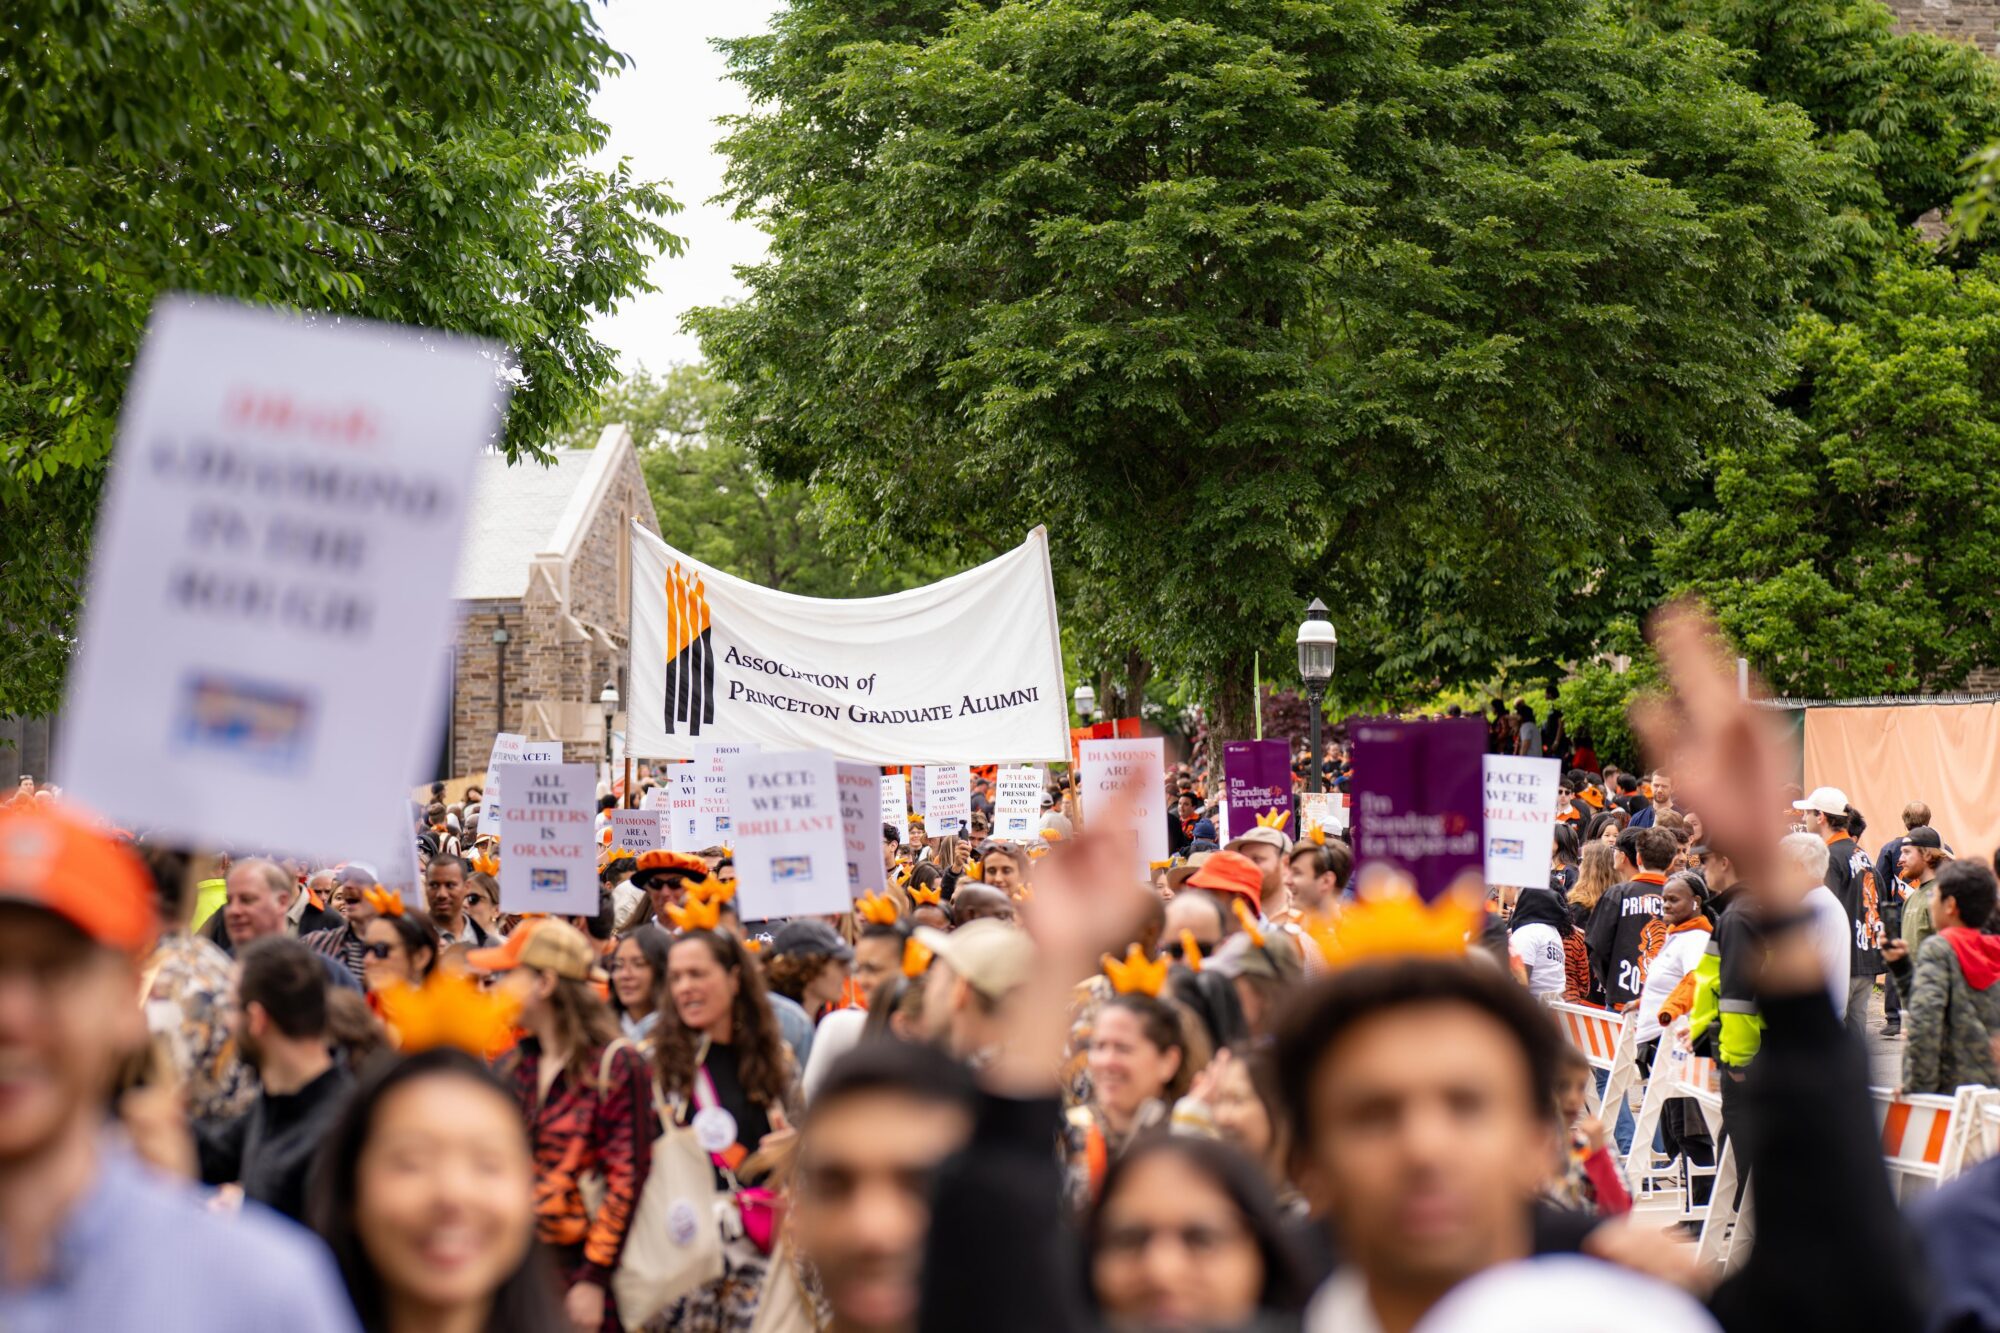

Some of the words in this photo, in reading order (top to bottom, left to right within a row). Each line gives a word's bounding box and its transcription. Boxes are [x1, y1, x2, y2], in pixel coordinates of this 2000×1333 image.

[856, 674, 876, 695] of
[523, 752, 551, 761] ACET:
[1087, 751, 1157, 762] DIAMONDS
[1104, 766, 1132, 776] ARE
[531, 774, 565, 788] ALL
[747, 771, 815, 789] FACET:
[837, 774, 874, 787] MONDS
[1100, 781, 1147, 791] GRAS
[1231, 777, 1245, 788] I'm
[1486, 771, 1541, 787] FACET:
[526, 791, 569, 805] THAT
[751, 794, 816, 811] WE'RE
[1232, 797, 1244, 808] for
[1244, 797, 1273, 809] higher
[1273, 794, 1288, 806] ed!
[1486, 789, 1538, 805] WE'RE
[506, 808, 589, 822] GLITTERS
[841, 807, 864, 819] D'S
[1484, 807, 1551, 824] RILLANT
[615, 817, 657, 825] DIAMONDS
[736, 815, 834, 837] BRILLANT
[540, 827, 556, 840] IS
[625, 828, 641, 836] ARE
[622, 838, 651, 847] GRAD'S
[512, 843, 584, 858] ORANGE
[1621, 896, 1665, 917] PRINC
[1618, 958, 1641, 996] 20
